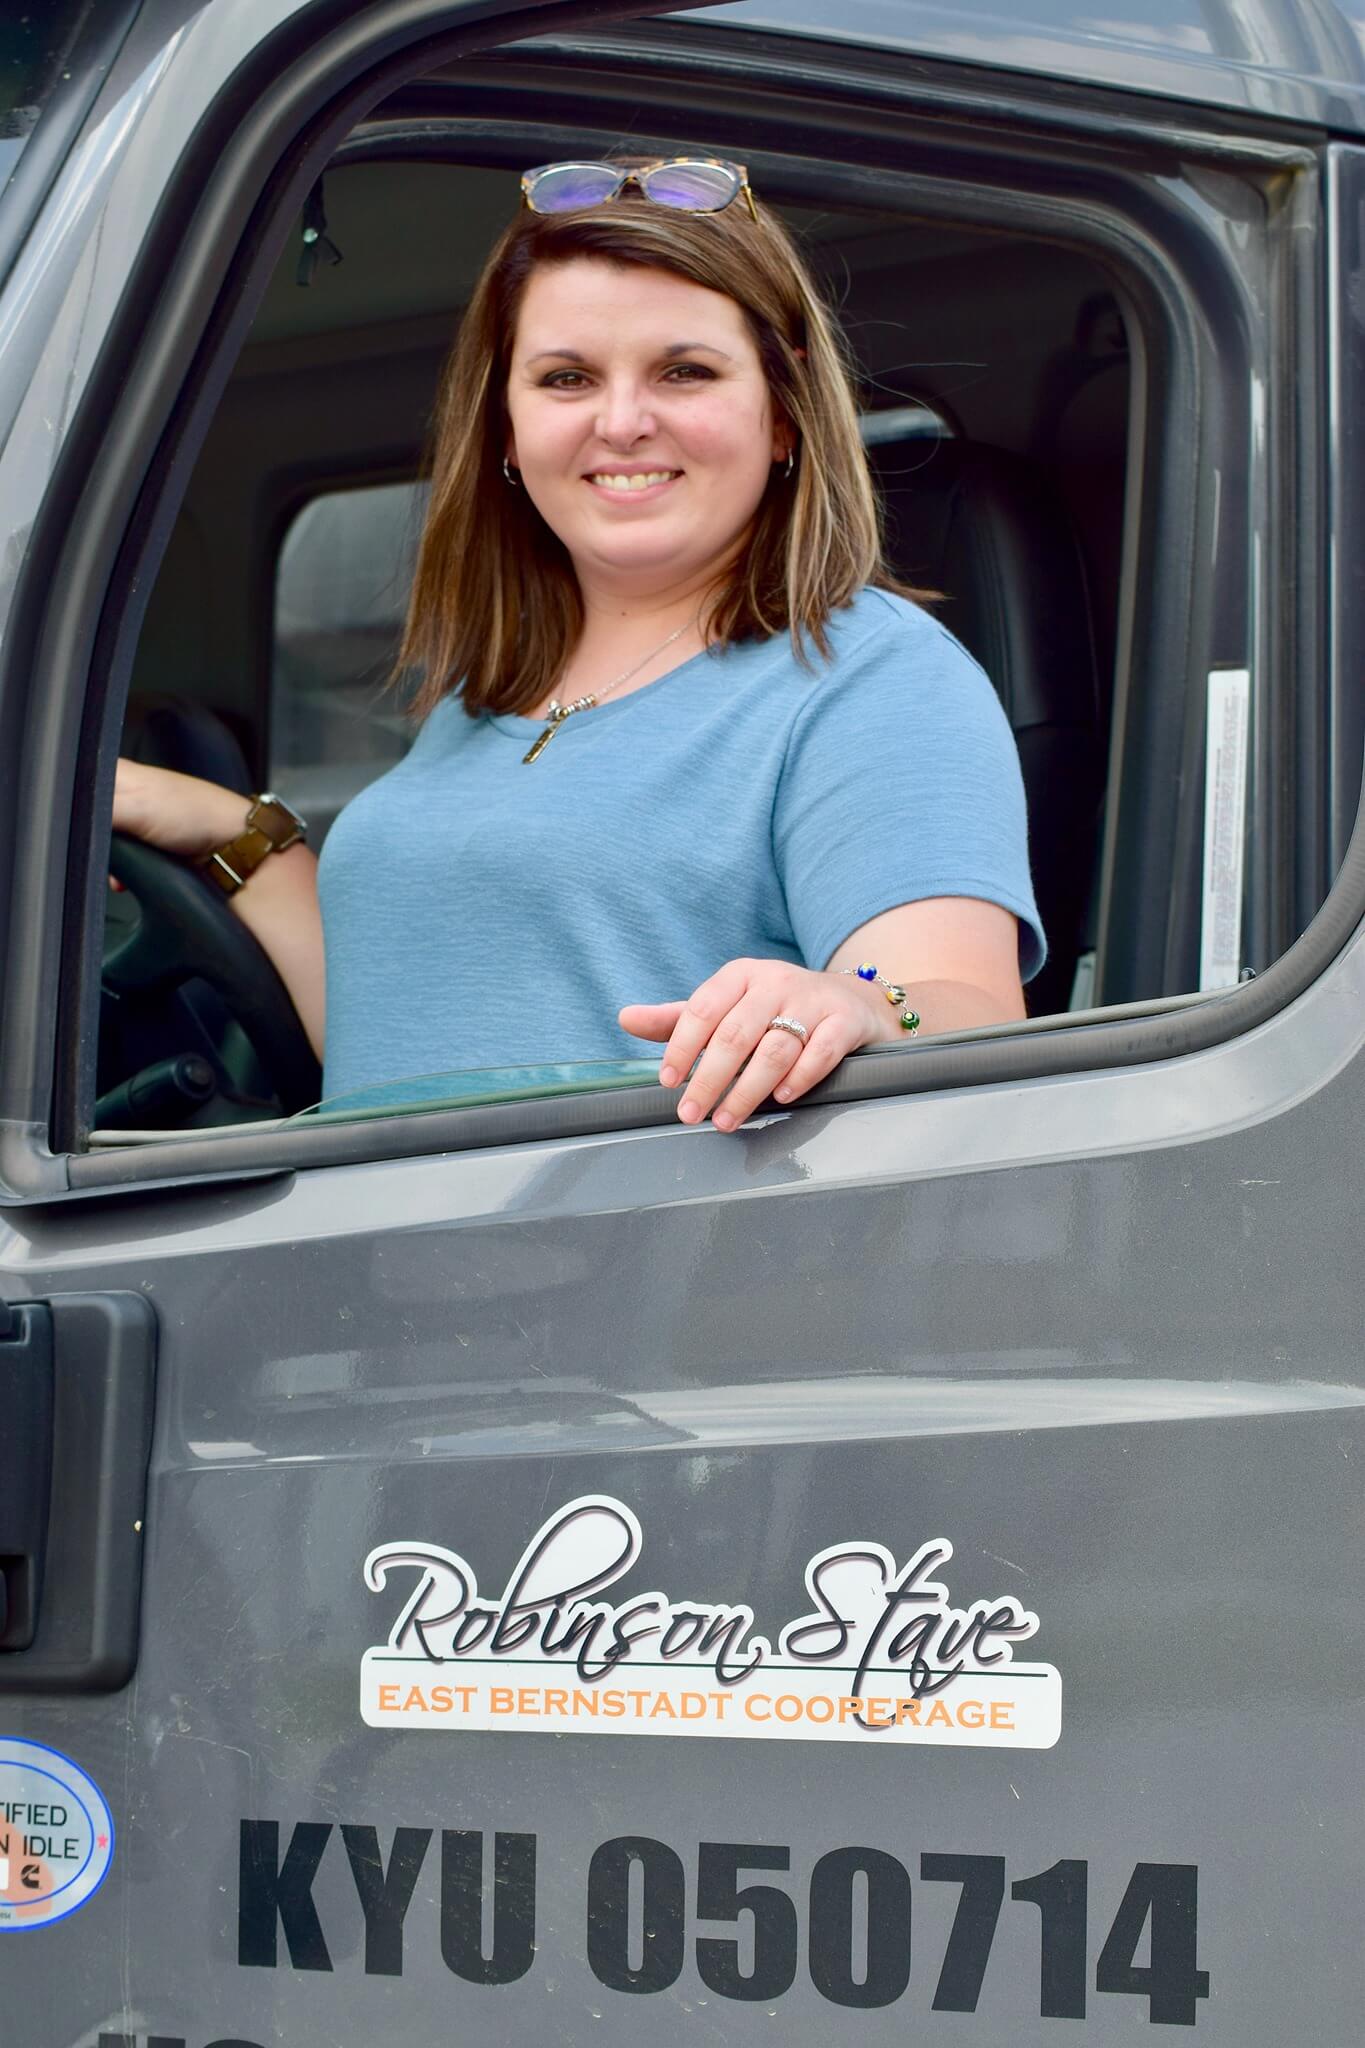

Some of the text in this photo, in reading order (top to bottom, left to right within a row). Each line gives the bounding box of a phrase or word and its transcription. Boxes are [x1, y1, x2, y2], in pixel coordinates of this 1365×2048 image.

[371, 1504, 1030, 1730] Robinson Stave
[378, 1684, 1015, 1730] EAST BERNSTADT COOPERAGE
[23, 1835, 79, 1860] IDLE
[238, 1818, 1210, 2026] KYU 050714
